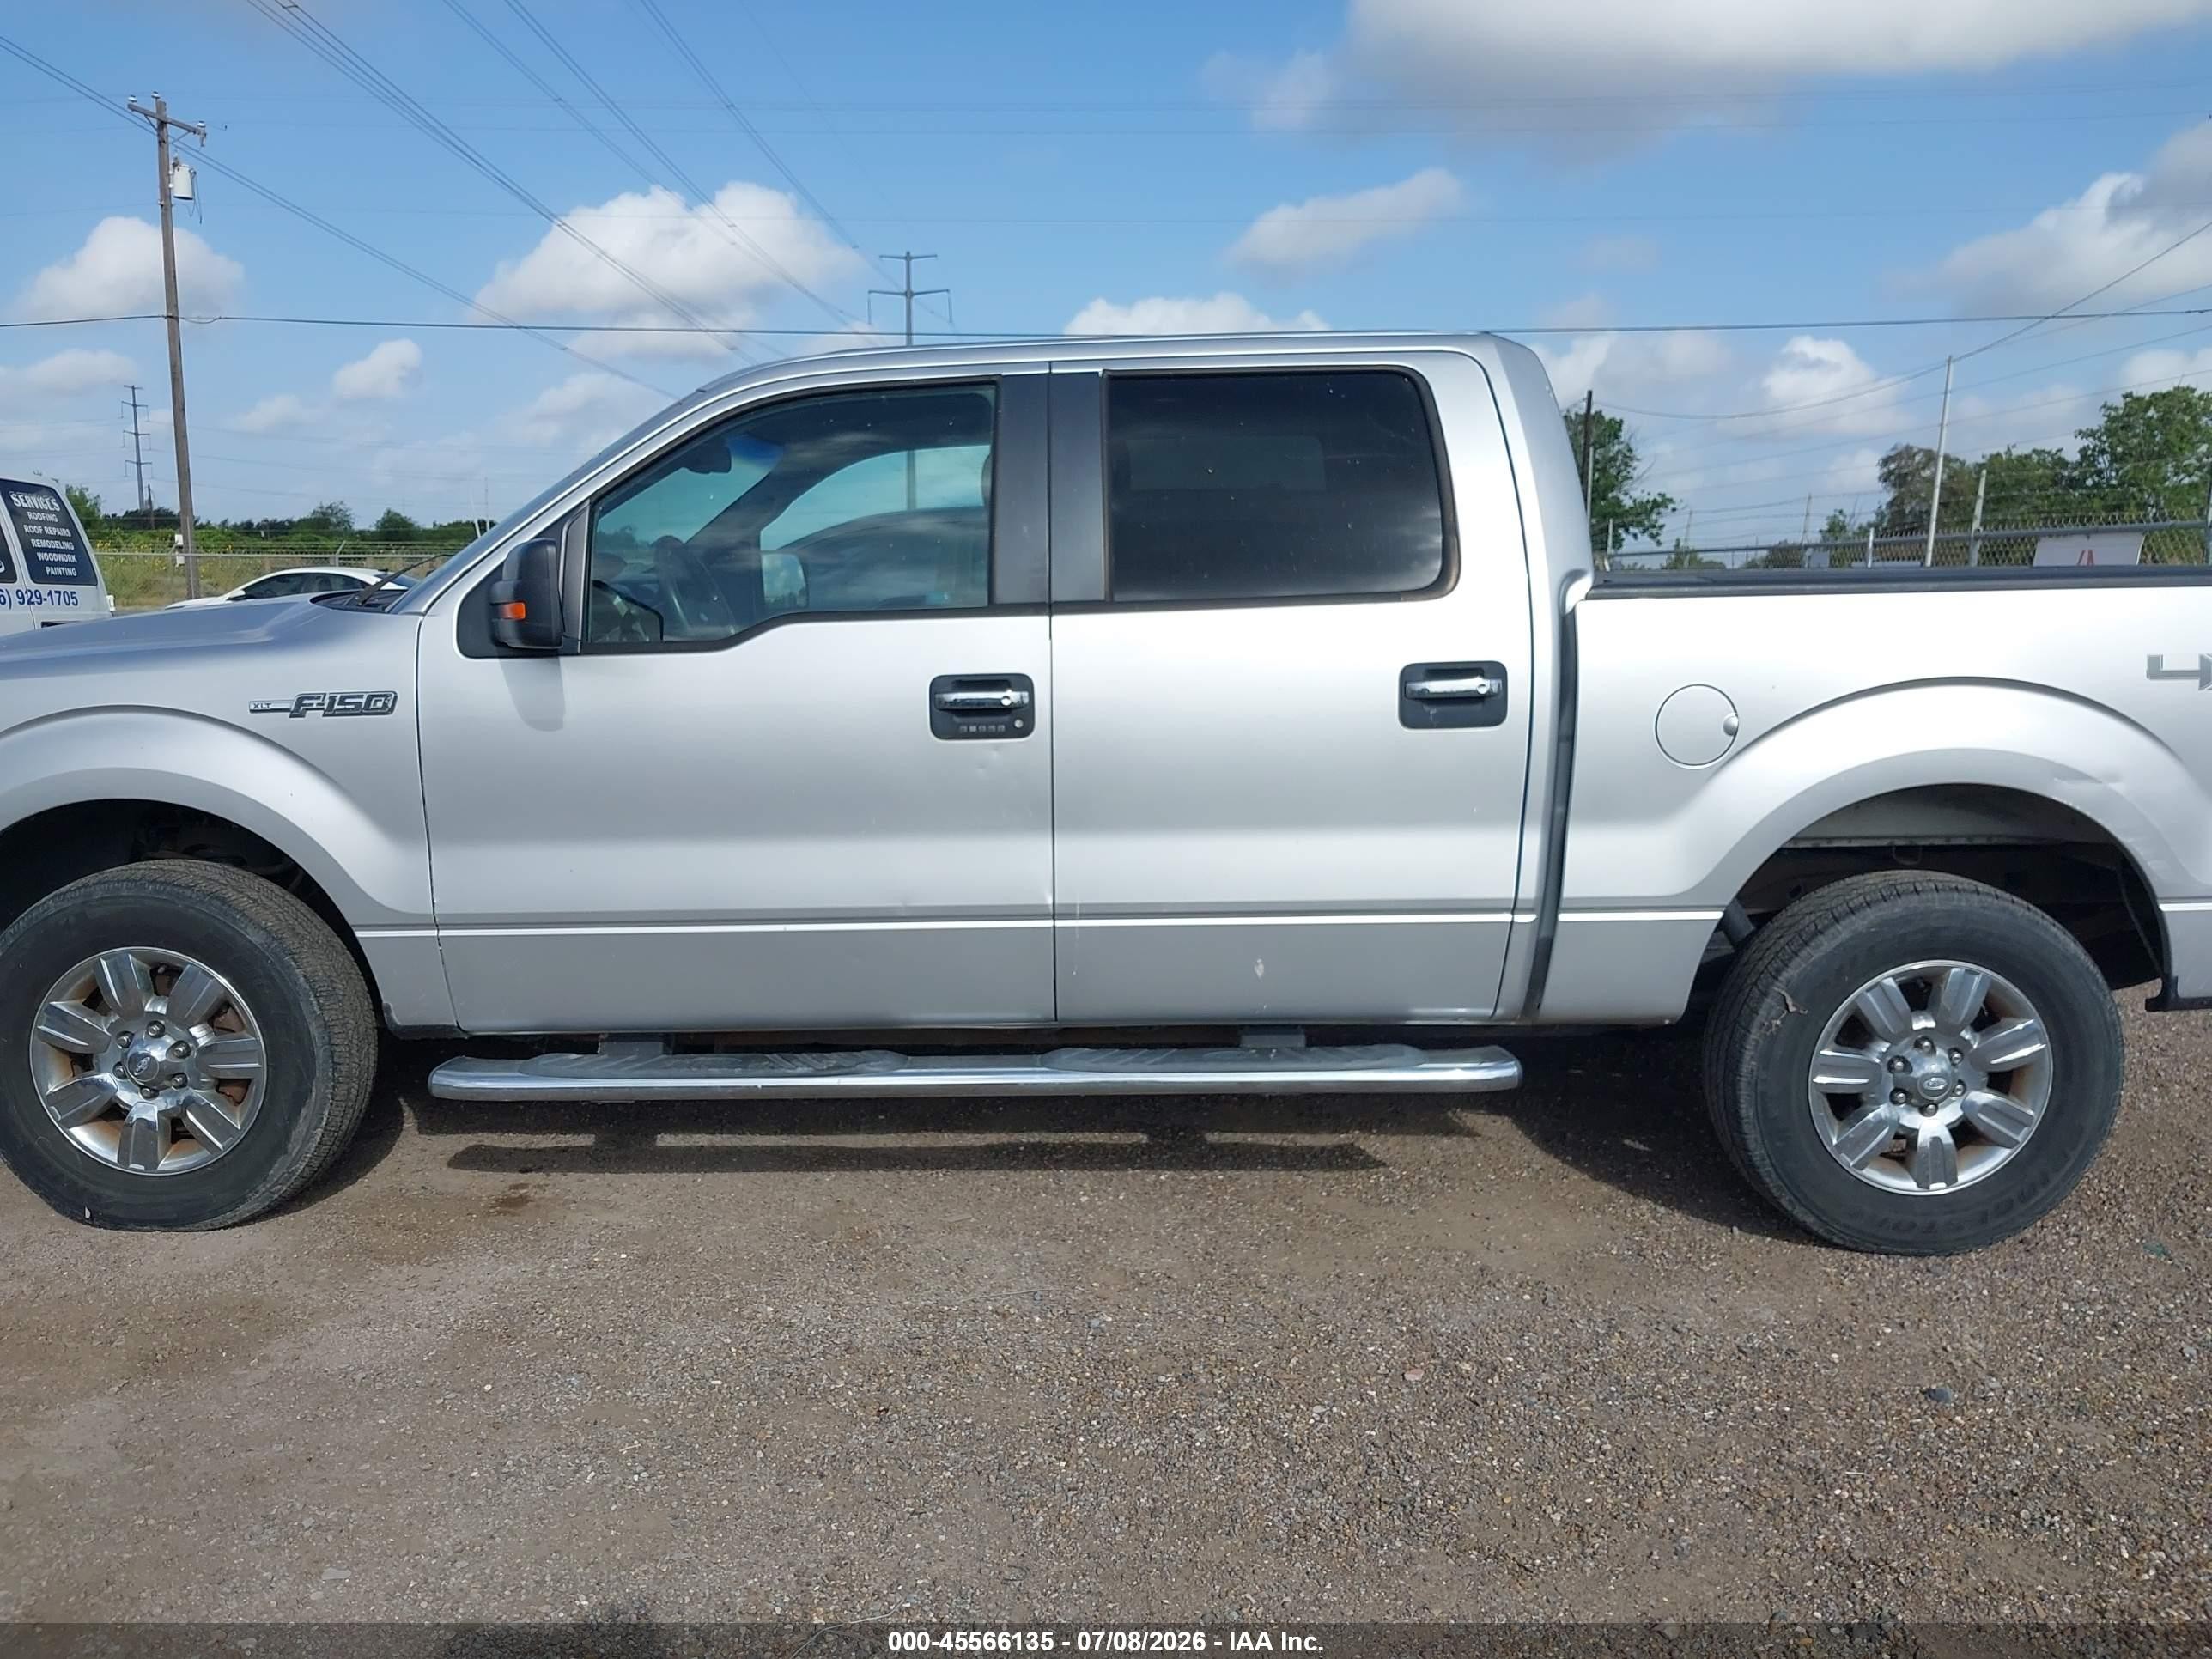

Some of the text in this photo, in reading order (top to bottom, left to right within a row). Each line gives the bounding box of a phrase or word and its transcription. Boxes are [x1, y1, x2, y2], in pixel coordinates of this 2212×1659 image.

[10, 493, 60, 512] SERVICES
[27, 511, 58, 523] ROOFING
[23, 525, 71, 538] ROOF REPAIRS
[31, 538, 75, 550] REMODELING
[37, 552, 77, 563] WOODWORK
[46, 566, 77, 577] PAINTING
[15, 588, 79, 606] 929-1705
[289, 690, 398, 718] F-150
